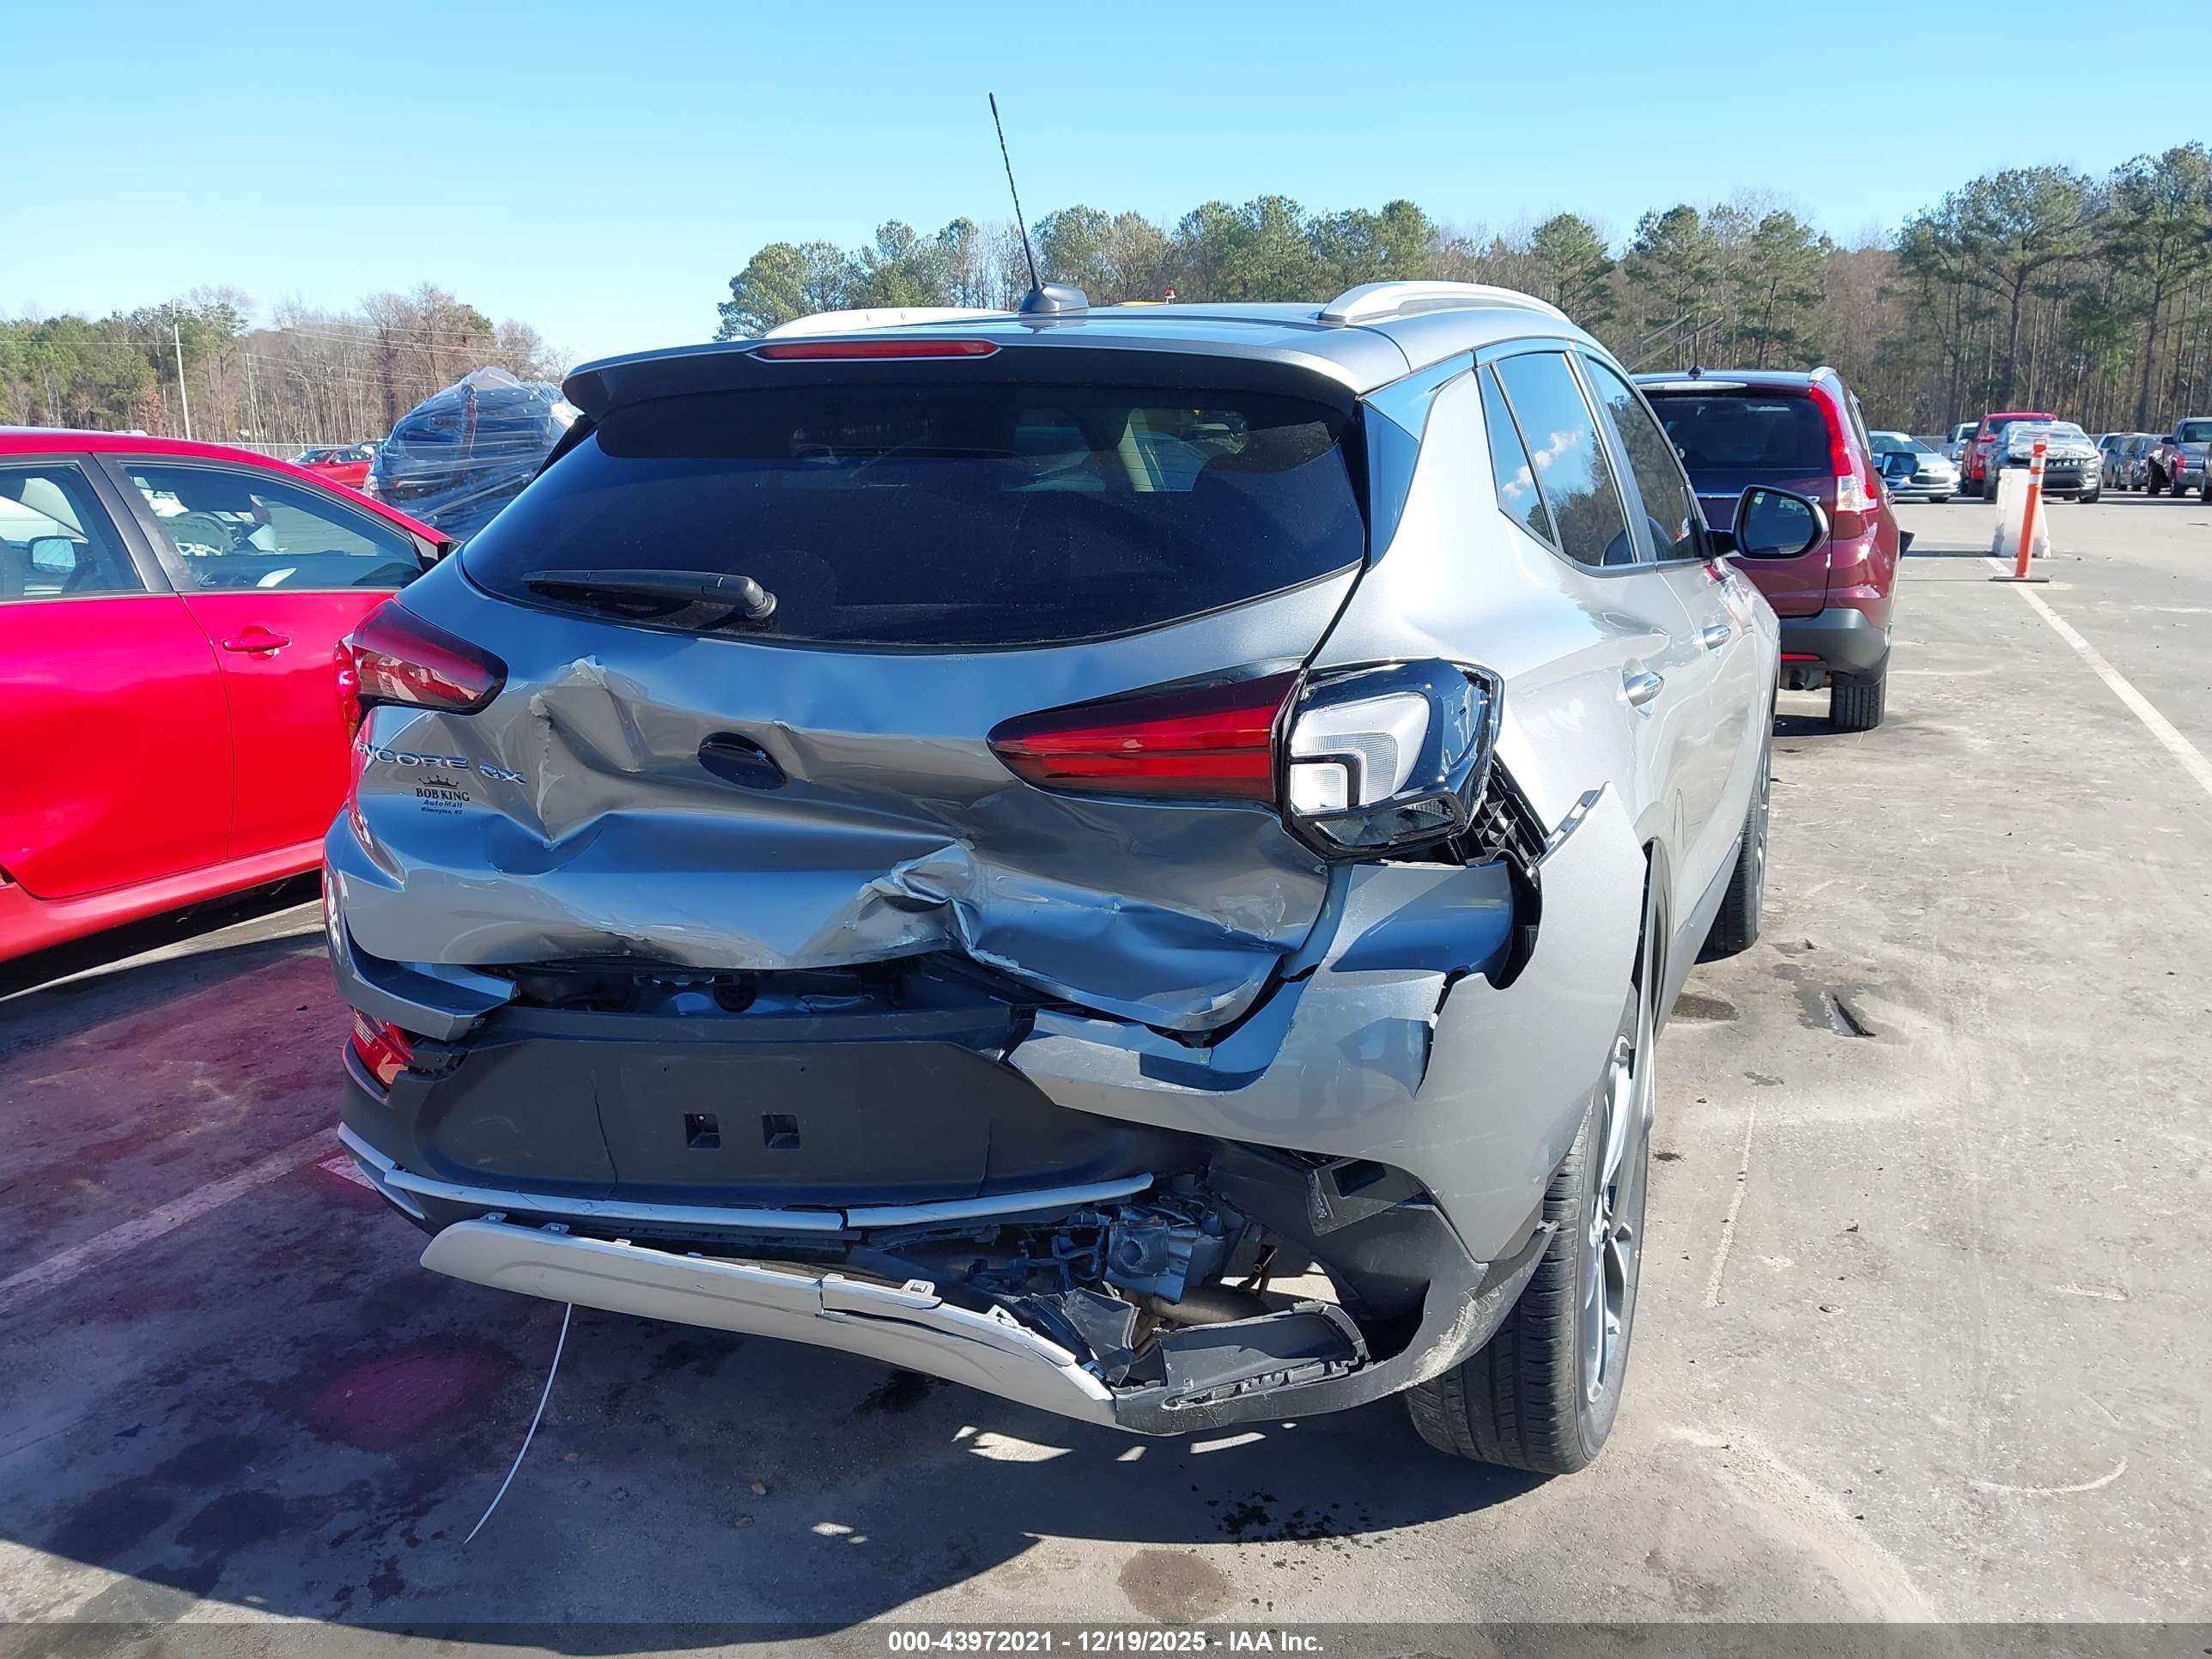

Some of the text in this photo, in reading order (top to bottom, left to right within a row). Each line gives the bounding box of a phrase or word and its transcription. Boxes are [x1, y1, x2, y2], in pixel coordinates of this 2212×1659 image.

[479, 763, 526, 785] GX
[416, 787, 470, 801] BOB KING
[423, 799, 463, 808] AutoMall
